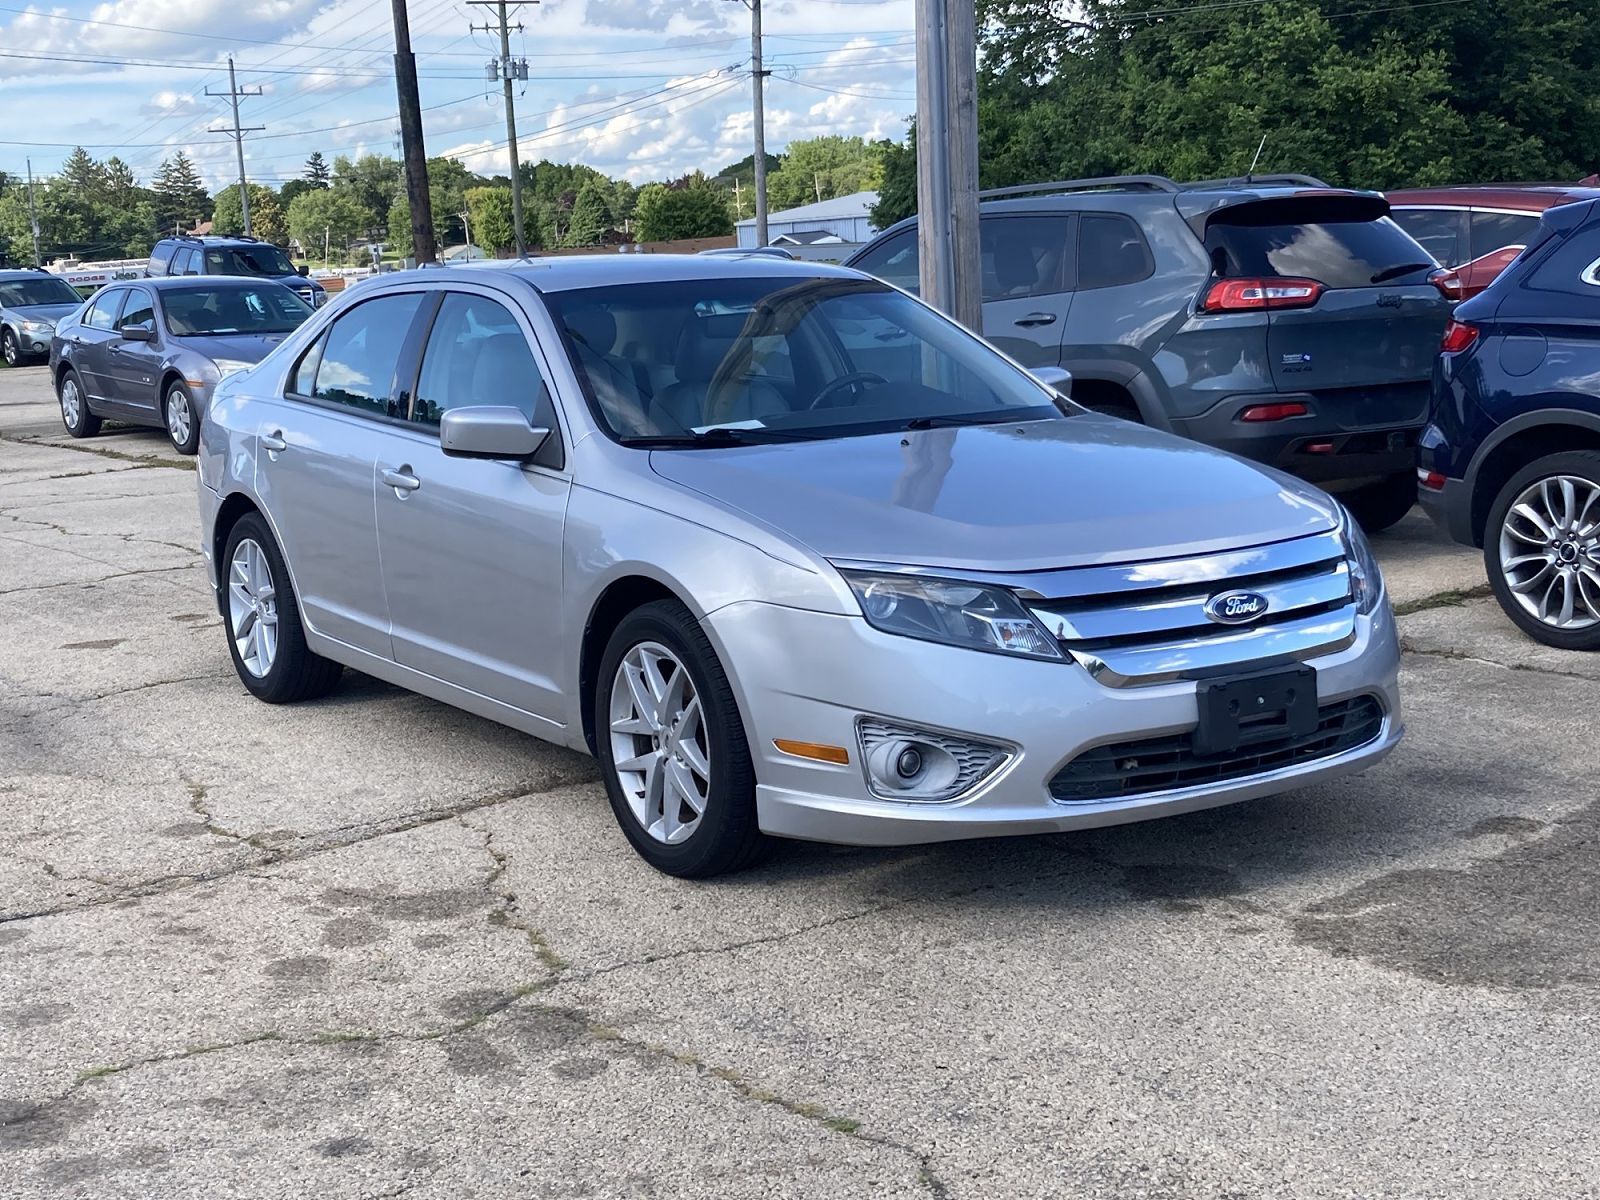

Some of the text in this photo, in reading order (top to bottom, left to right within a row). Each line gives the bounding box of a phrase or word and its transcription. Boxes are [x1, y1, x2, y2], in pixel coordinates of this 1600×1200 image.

[68, 275, 106, 283] DODGE
[111, 271, 138, 281] Jeep
[1225, 595, 1258, 616] Ford
